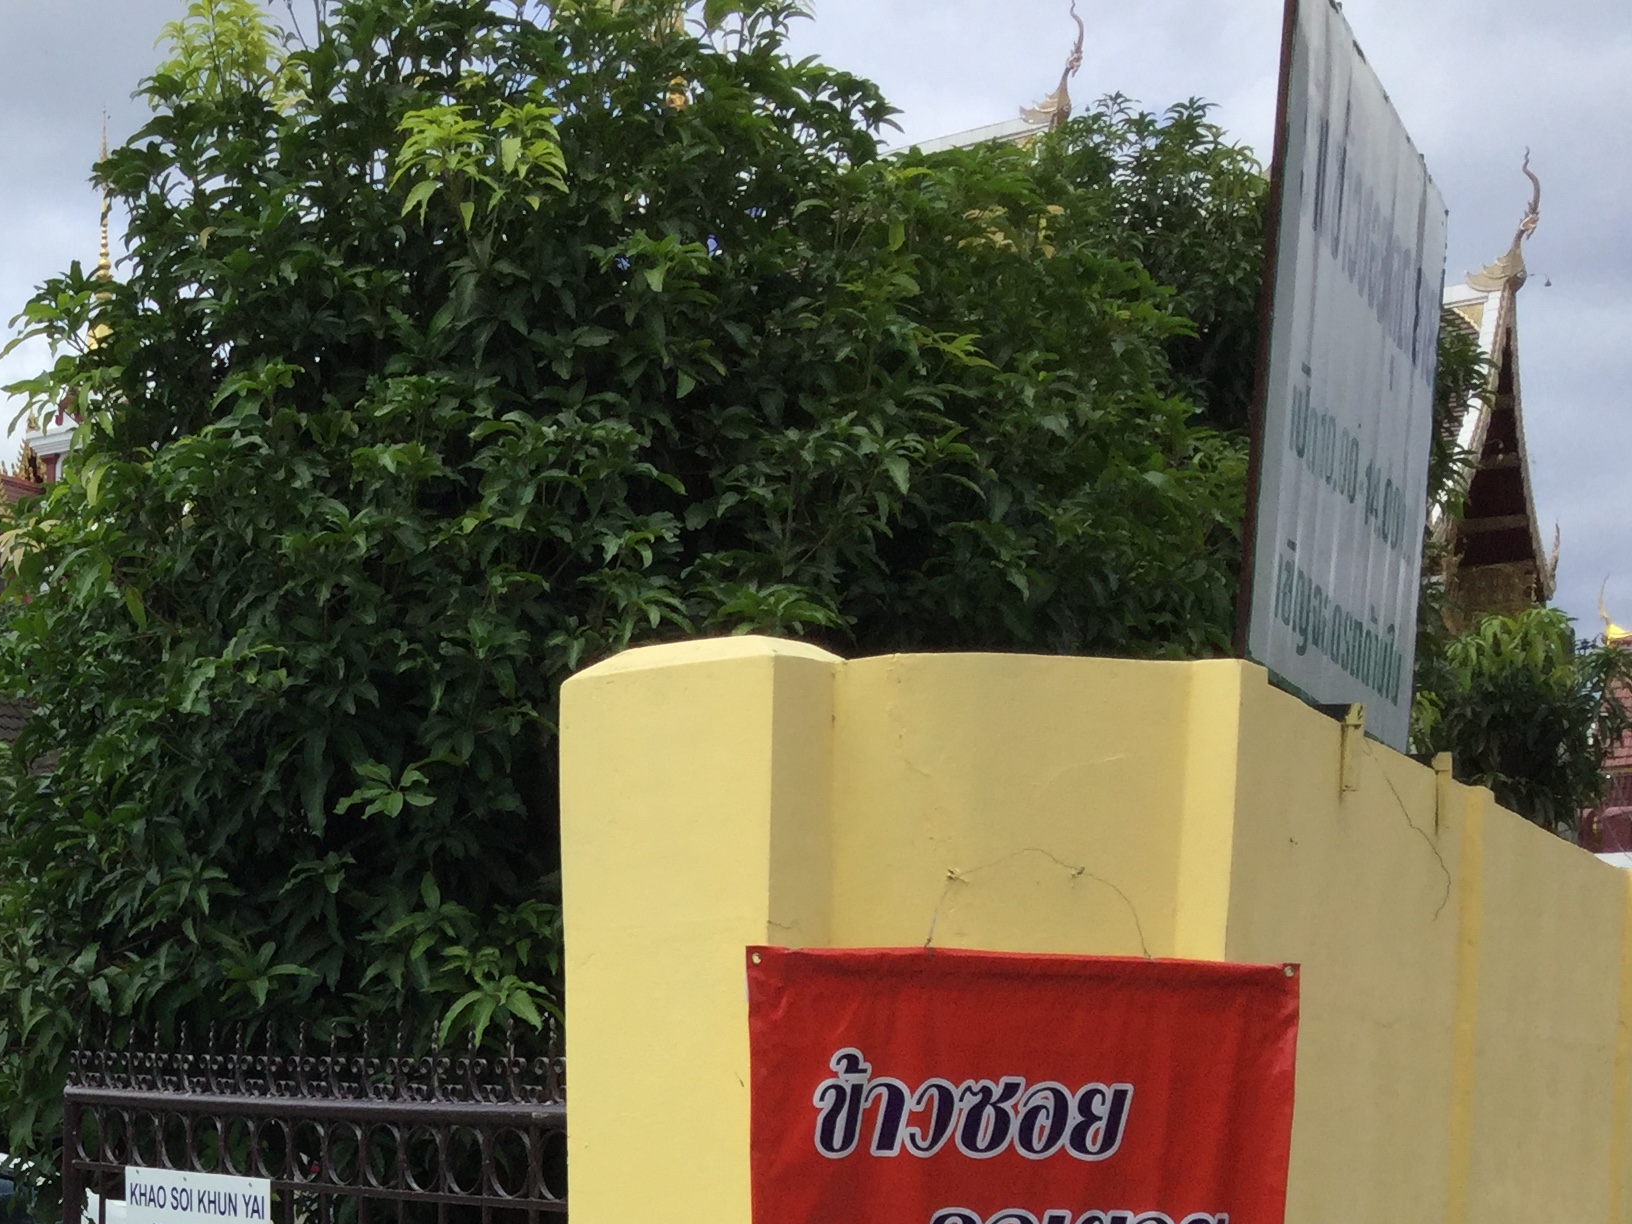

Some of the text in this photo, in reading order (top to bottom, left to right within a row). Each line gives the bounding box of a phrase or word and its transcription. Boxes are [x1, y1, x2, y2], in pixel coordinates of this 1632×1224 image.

[814, 1048, 1133, 1160] ข้าวซอย
[130, 1182, 265, 1220] KHAO SOI KHUN YAI
